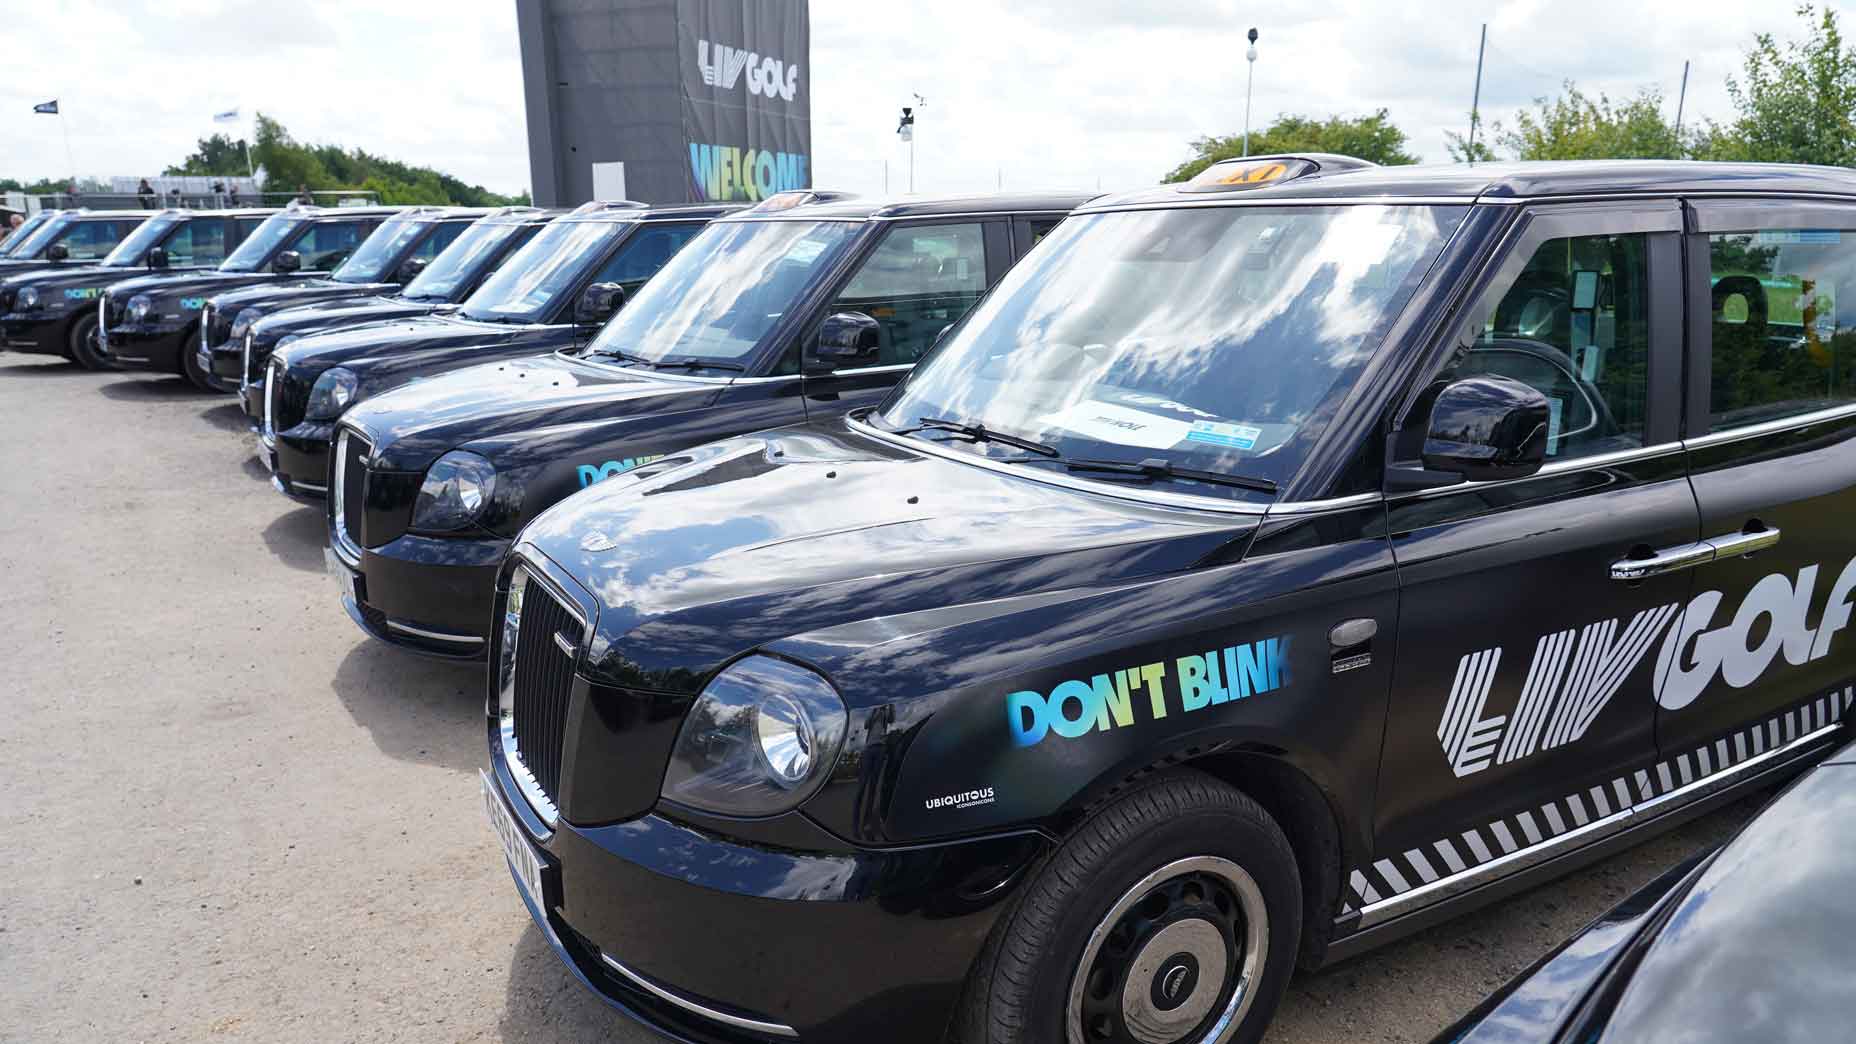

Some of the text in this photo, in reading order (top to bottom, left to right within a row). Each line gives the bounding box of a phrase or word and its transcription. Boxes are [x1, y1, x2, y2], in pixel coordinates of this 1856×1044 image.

[698, 39, 798, 101] LIV GOLF
[689, 142, 808, 201] WELCOME
[1006, 635, 1294, 748] DON'T BLINK
[1436, 556, 1856, 778] LIV GOLF
[925, 787, 994, 809] UBIQUITOUS
